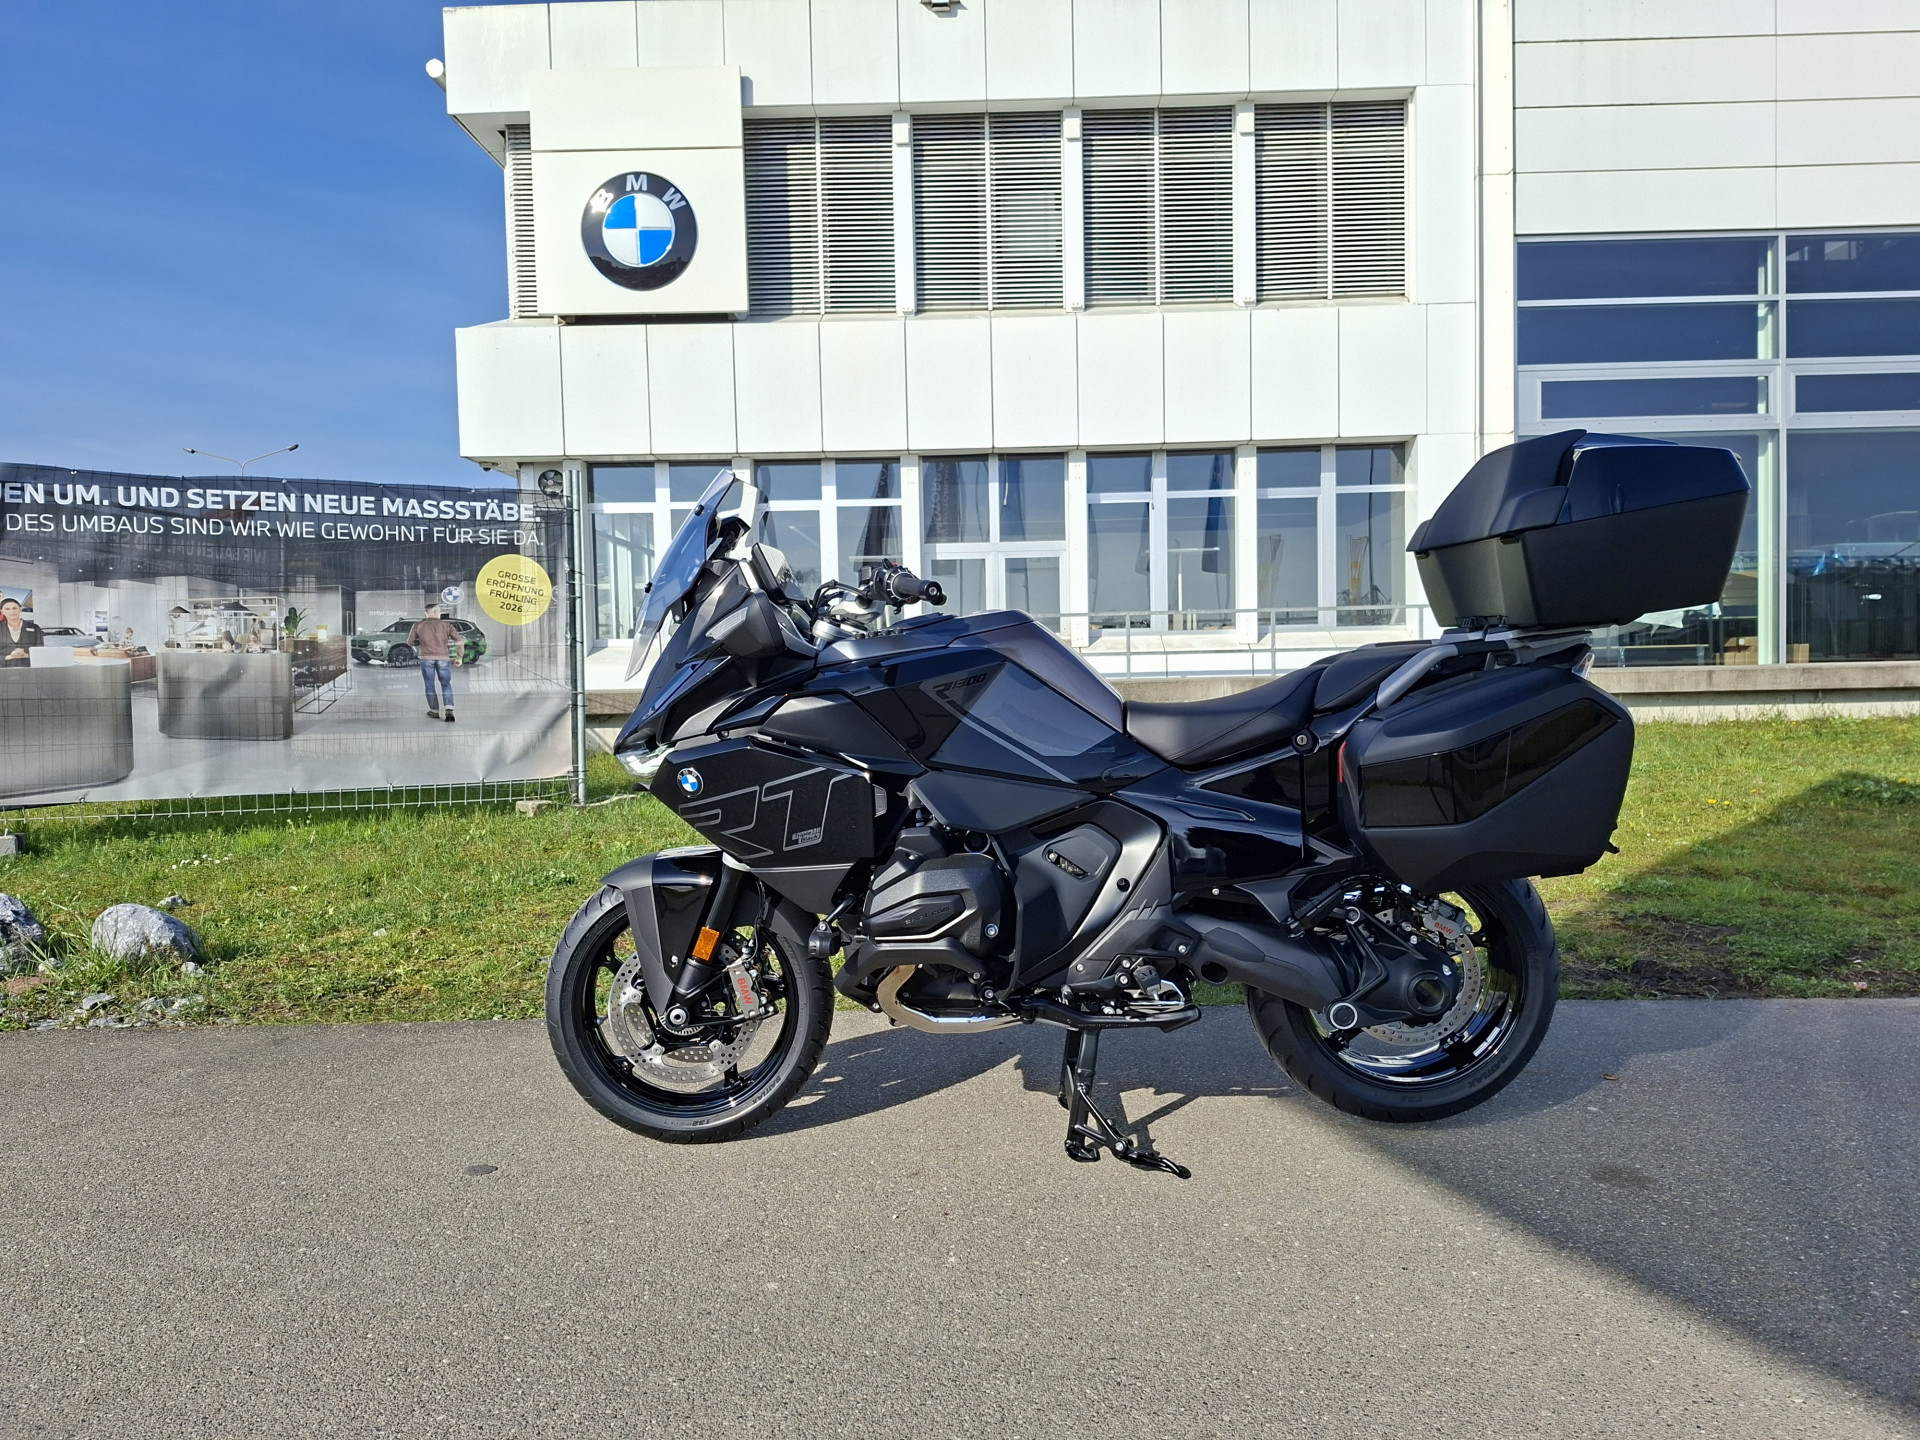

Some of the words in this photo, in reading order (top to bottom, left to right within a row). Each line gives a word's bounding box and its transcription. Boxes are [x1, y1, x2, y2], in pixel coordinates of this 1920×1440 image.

[590, 174, 687, 214] BMW
[0, 482, 45, 504] EN
[53, 483, 109, 506] UM.
[117, 485, 180, 508] UND
[187, 488, 296, 513] SETZEN
[305, 493, 376, 516] NEUE
[383, 497, 541, 523] MASSSTÄBE.
[6, 513, 55, 532] DES
[62, 514, 164, 534] UMBAUS
[171, 517, 224, 536] SIND
[230, 519, 271, 538] WIR
[276, 521, 316, 539] WIE
[321, 522, 429, 543] GEWOHNT
[433, 524, 474, 545] FÜR
[478, 528, 508, 546] SIE
[514, 530, 544, 546] DA.
[497, 570, 537, 585] GROSSE
[486, 578, 544, 597] ERÖFFNUNG
[489, 588, 538, 606] FRÜHLING
[499, 601, 523, 613] 2026
[1433, 921, 1454, 935] BMW
[736, 977, 754, 1005] BMW
